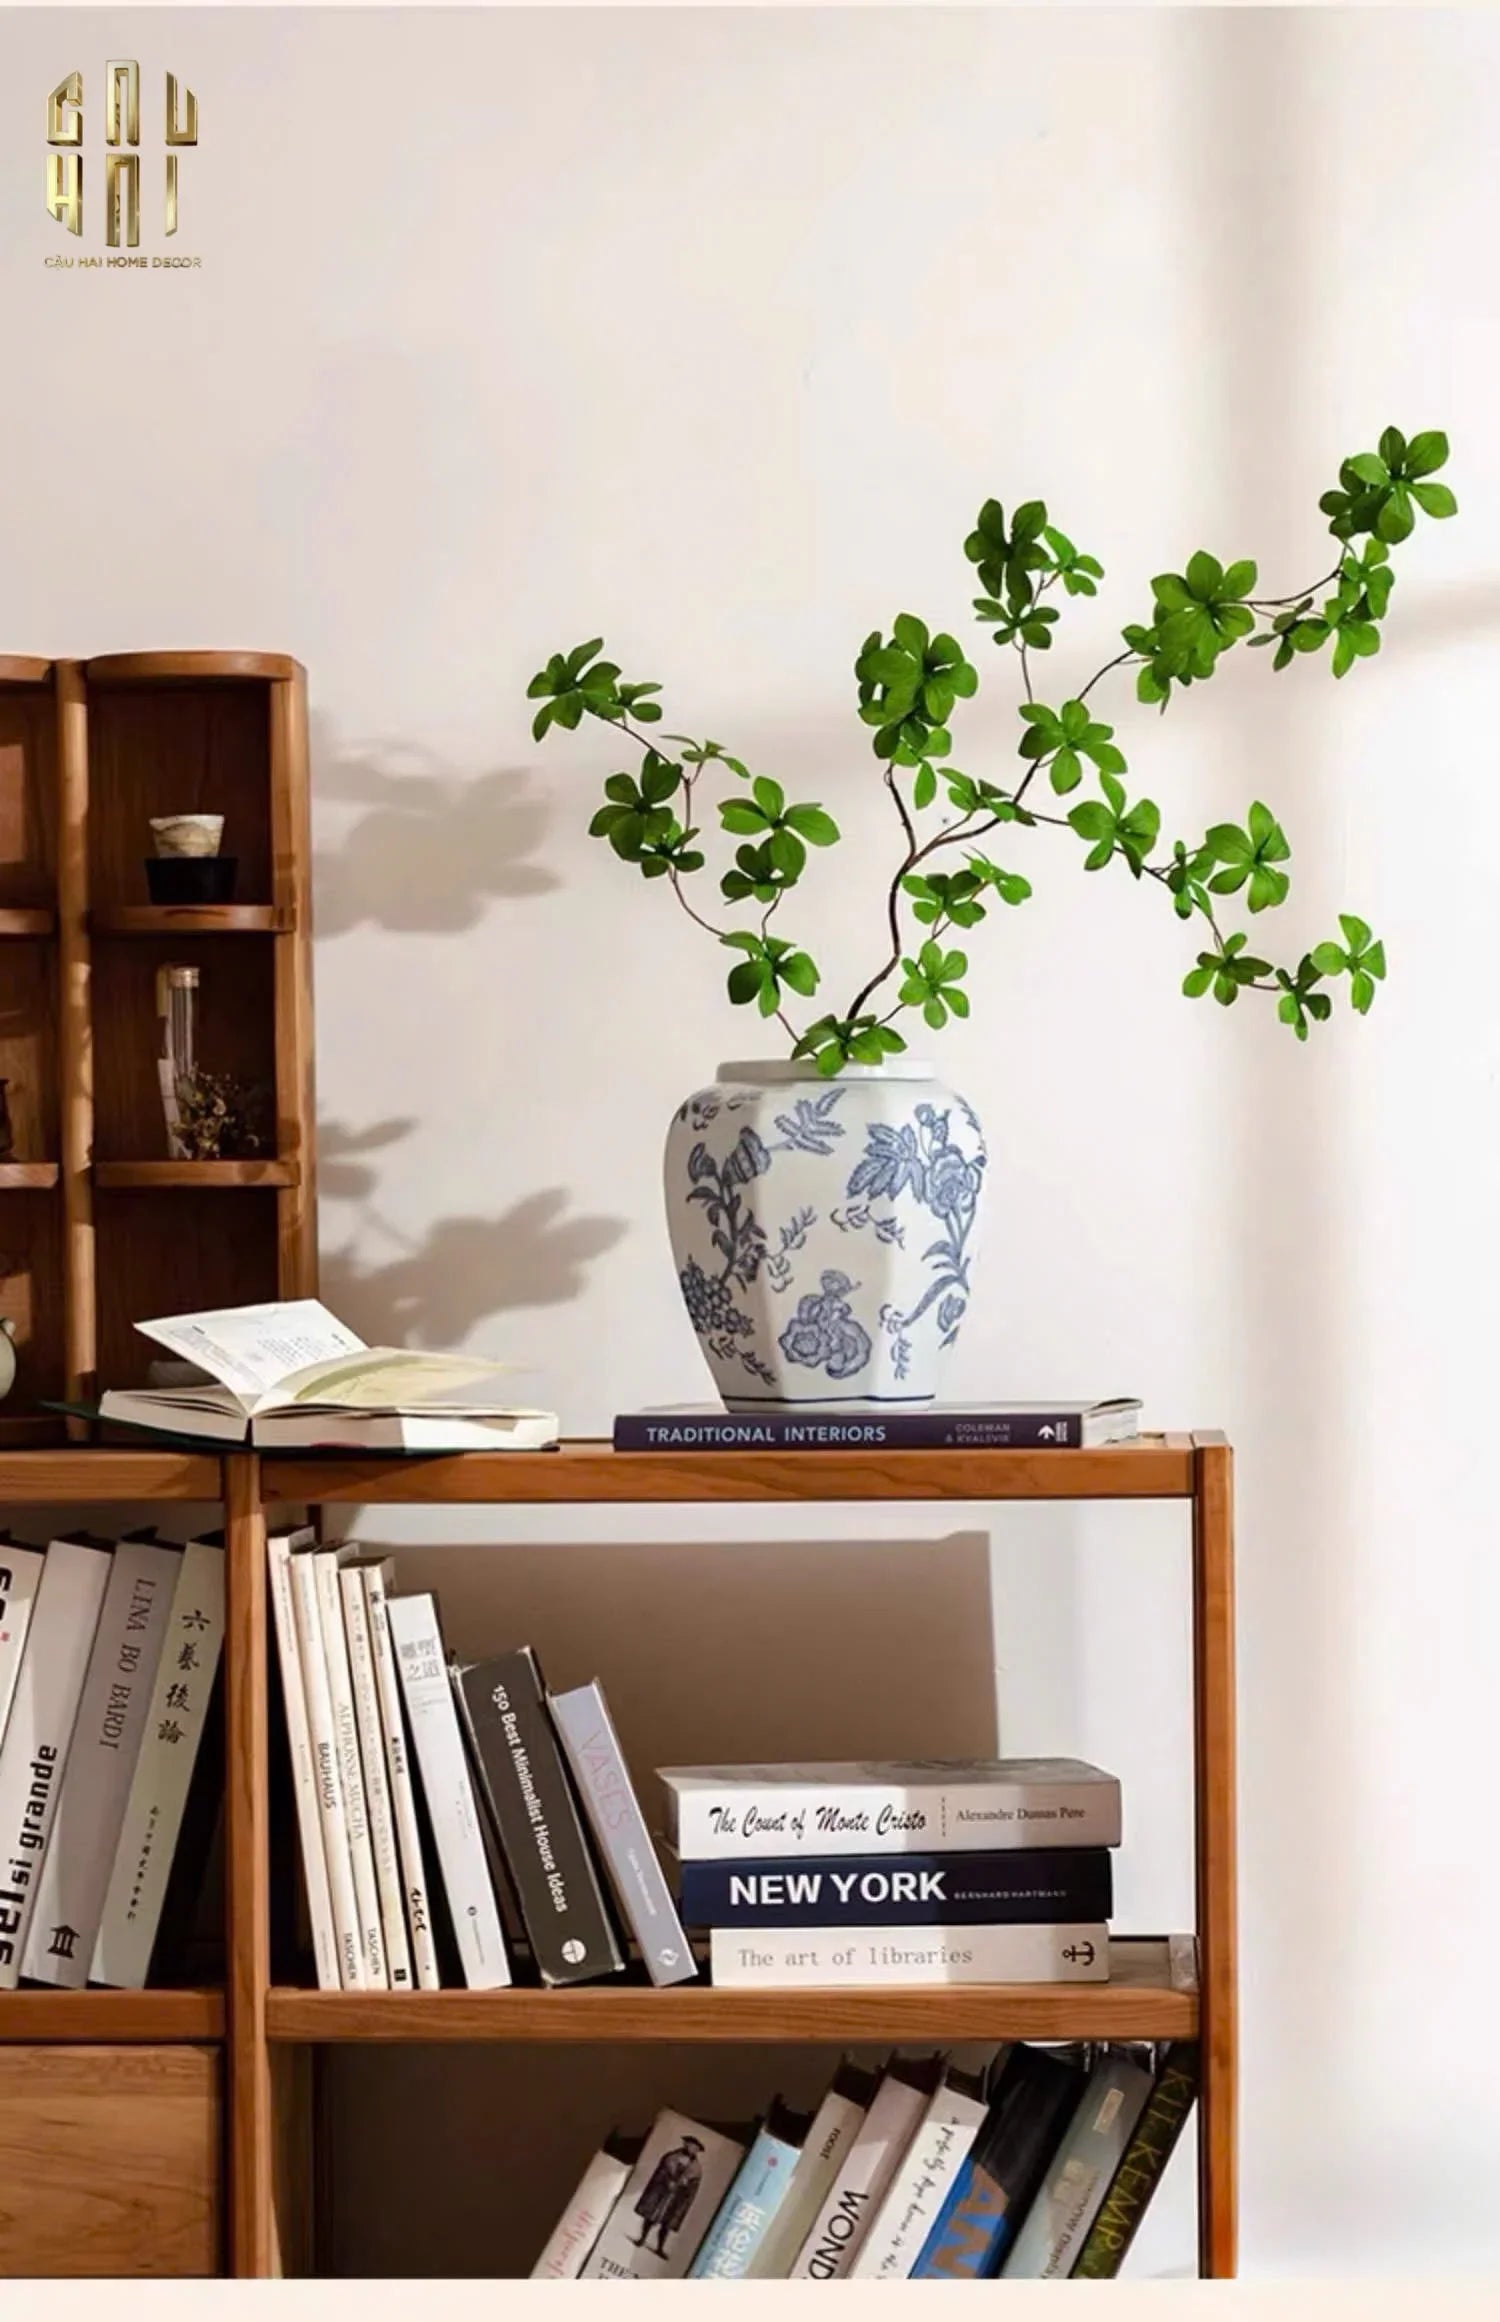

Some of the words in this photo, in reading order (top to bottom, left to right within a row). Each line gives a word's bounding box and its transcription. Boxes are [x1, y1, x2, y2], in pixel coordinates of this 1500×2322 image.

[646, 1426, 776, 1443] TRADITIONAL
[784, 1424, 886, 1443] INTERIORS
[955, 1423, 1010, 1433] COLEMAN
[125, 1578, 157, 1632] LINA
[117, 1641, 142, 1673] BO
[99, 1683, 132, 1750] BARDI
[491, 1684, 510, 1711] 150
[501, 1711, 522, 1747] Best
[19, 1744, 58, 1851] grande
[318, 1741, 337, 1810] BAUHAUS
[511, 1748, 544, 1825] Minimalist
[580, 1729, 631, 1831] VASES
[350, 1782, 366, 1841] MUCHA
[708, 1804, 738, 1836] The
[740, 1806, 788, 1839] Count
[790, 1809, 808, 1840] of
[815, 1805, 870, 1833] Monte
[875, 1803, 928, 1836] Cristo
[955, 1806, 1014, 1823] Alexandre
[1016, 1805, 1057, 1821] Dumas
[1059, 1805, 1086, 1820] Pere
[532, 1824, 557, 1872] House
[8, 1858, 33, 1887] si
[546, 1872, 569, 1914] Ideas
[729, 1873, 822, 1906] NEW
[829, 1871, 948, 1903] YORK
[954, 1890, 1009, 1900] BERNHARD
[367, 1927, 381, 1977] TASCHEN
[738, 1948, 775, 1968] The
[784, 1948, 820, 1968] art
[833, 1947, 857, 1967] of
[868, 1946, 973, 1967] libraries
[1147, 2067, 1193, 2130] KIT
[1096, 2139, 1163, 2251] KEMP
[805, 2190, 870, 2279] WOND
